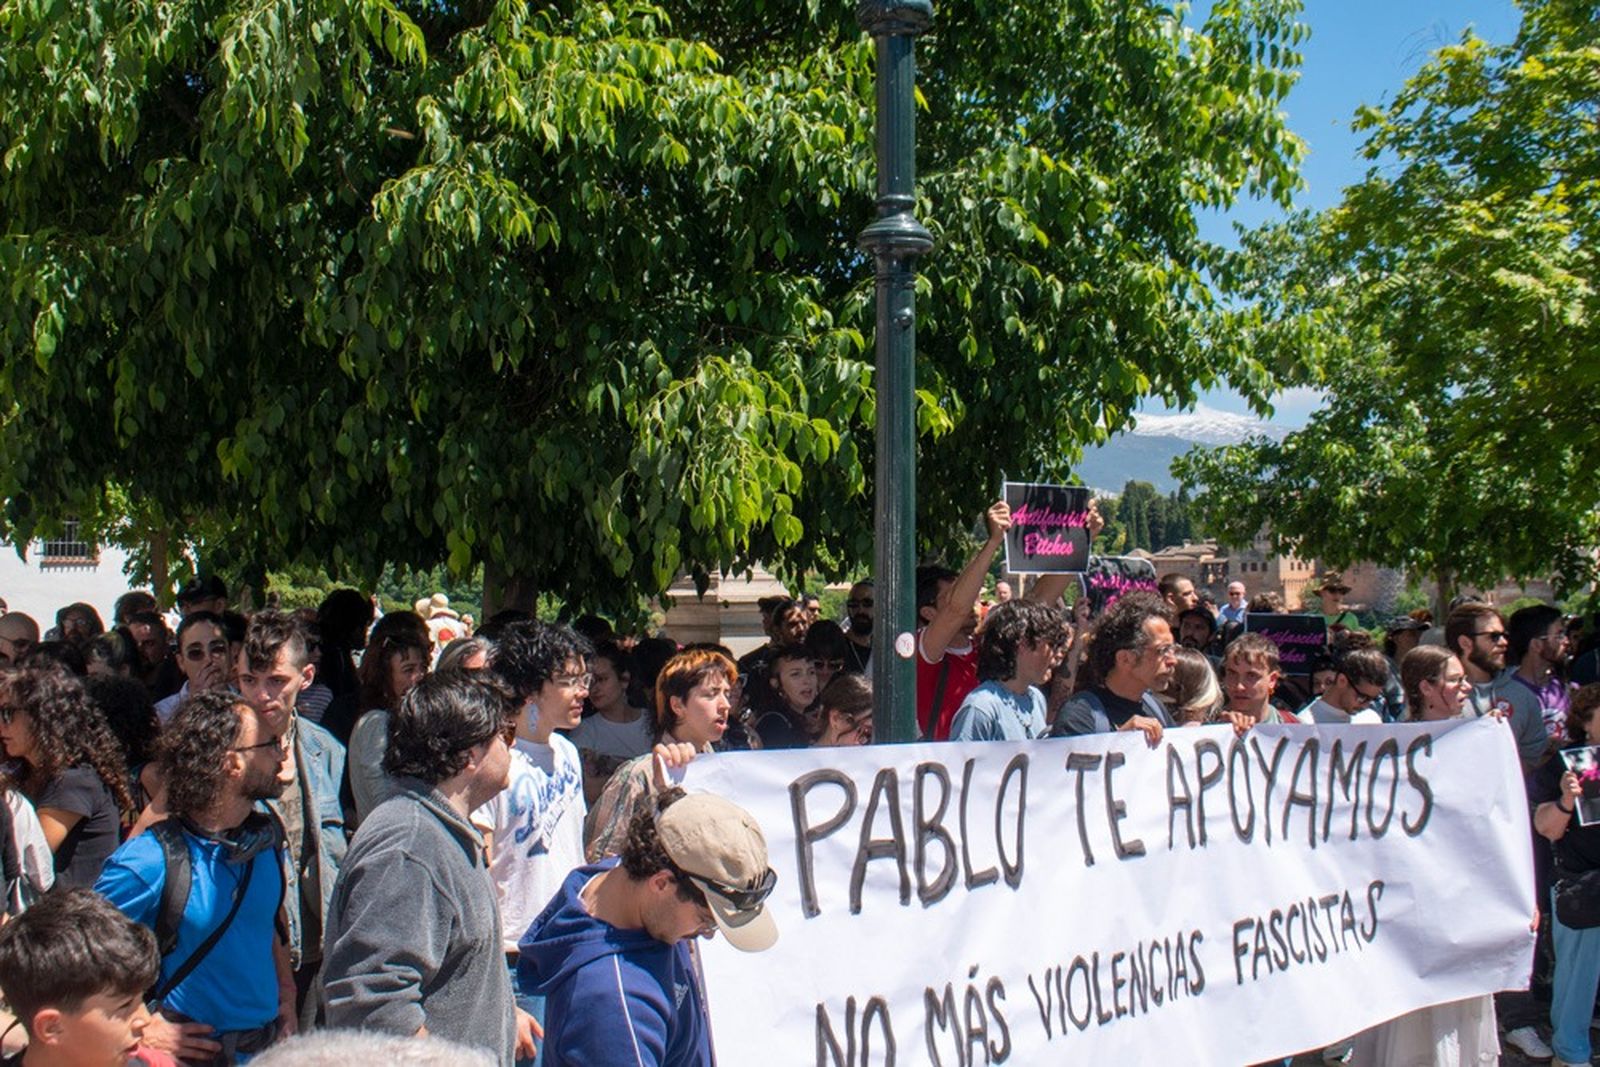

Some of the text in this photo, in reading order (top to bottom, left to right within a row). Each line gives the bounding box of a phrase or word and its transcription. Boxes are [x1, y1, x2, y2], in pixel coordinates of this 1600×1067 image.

[1009, 503, 1088, 533] Antifascist
[1023, 532, 1074, 556] Bitches
[788, 733, 1434, 919] PABLO TE APOYAMOS
[815, 879, 1386, 1067] NO MÁS VIOLENCIAS FASCISTAS
